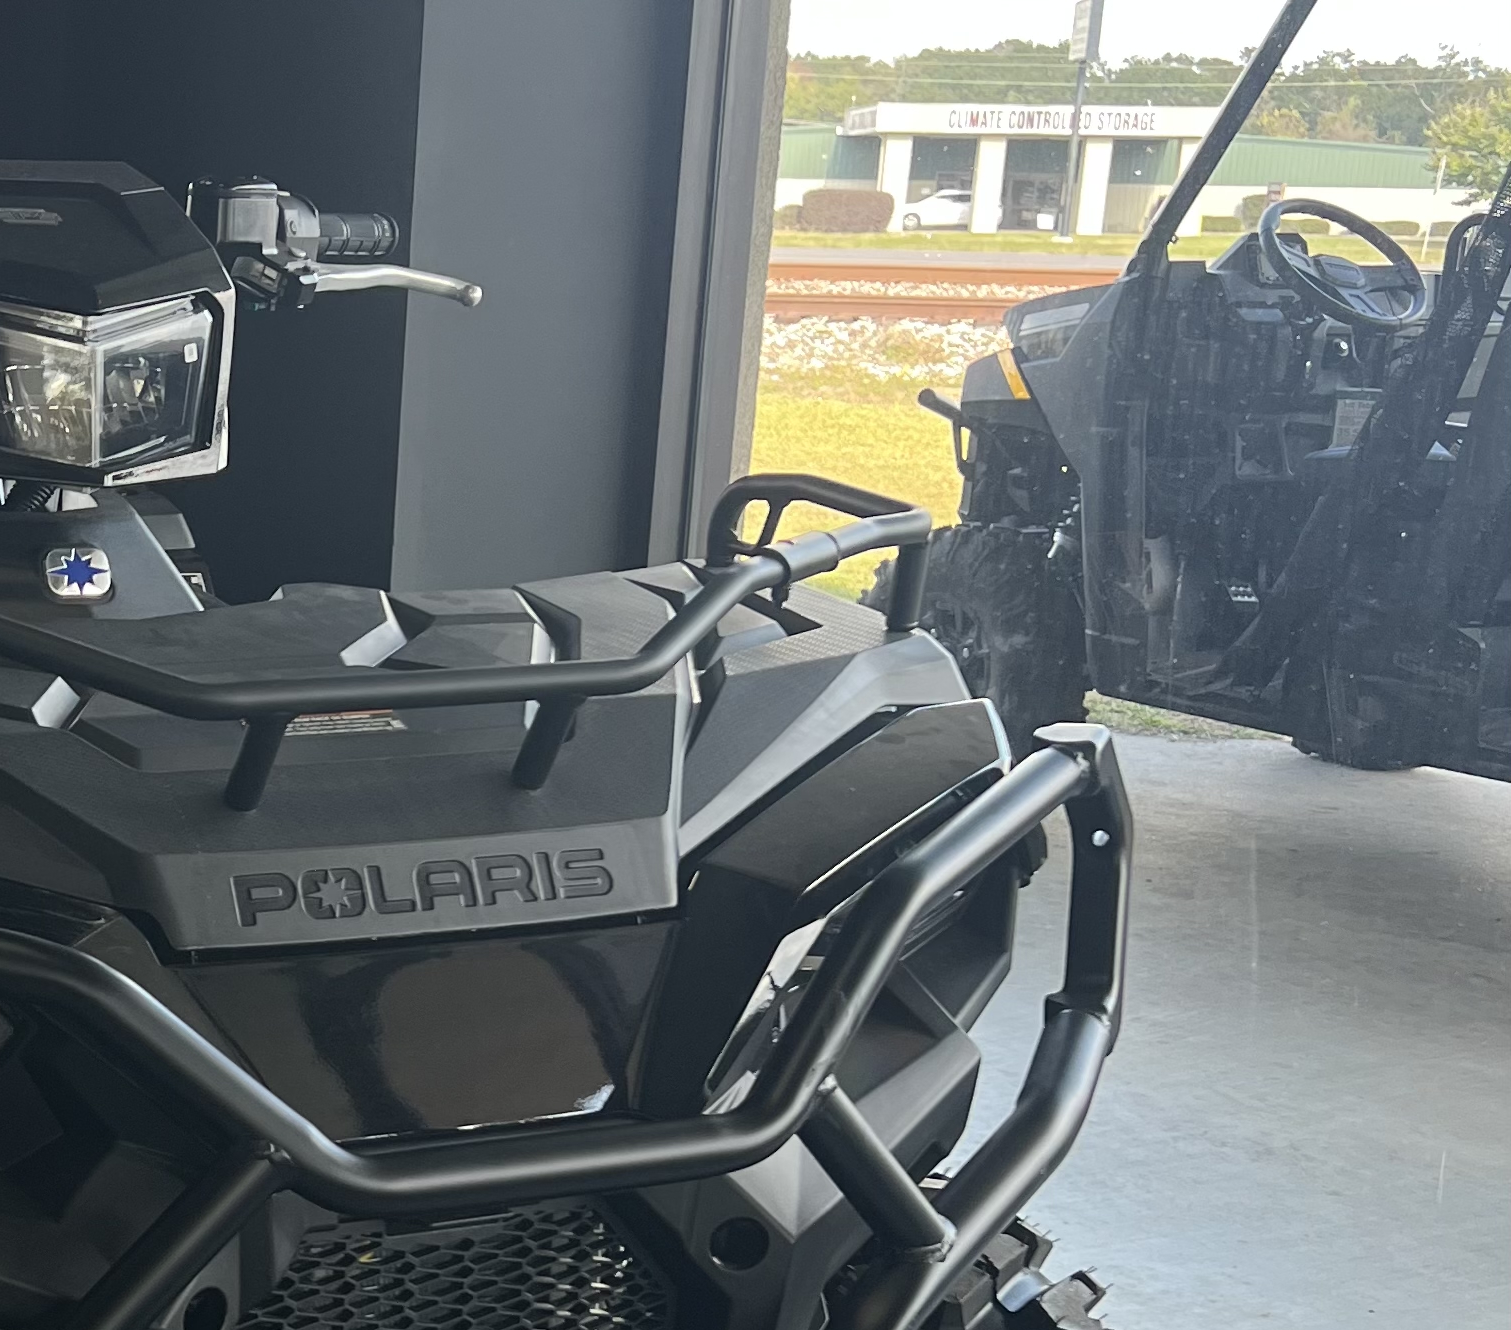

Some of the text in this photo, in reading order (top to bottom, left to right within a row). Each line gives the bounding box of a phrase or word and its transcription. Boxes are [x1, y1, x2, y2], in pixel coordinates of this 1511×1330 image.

[949, 110, 1156, 131] CLIMATE CONTROLD STORAGE
[230, 848, 613, 927] POLARIS
